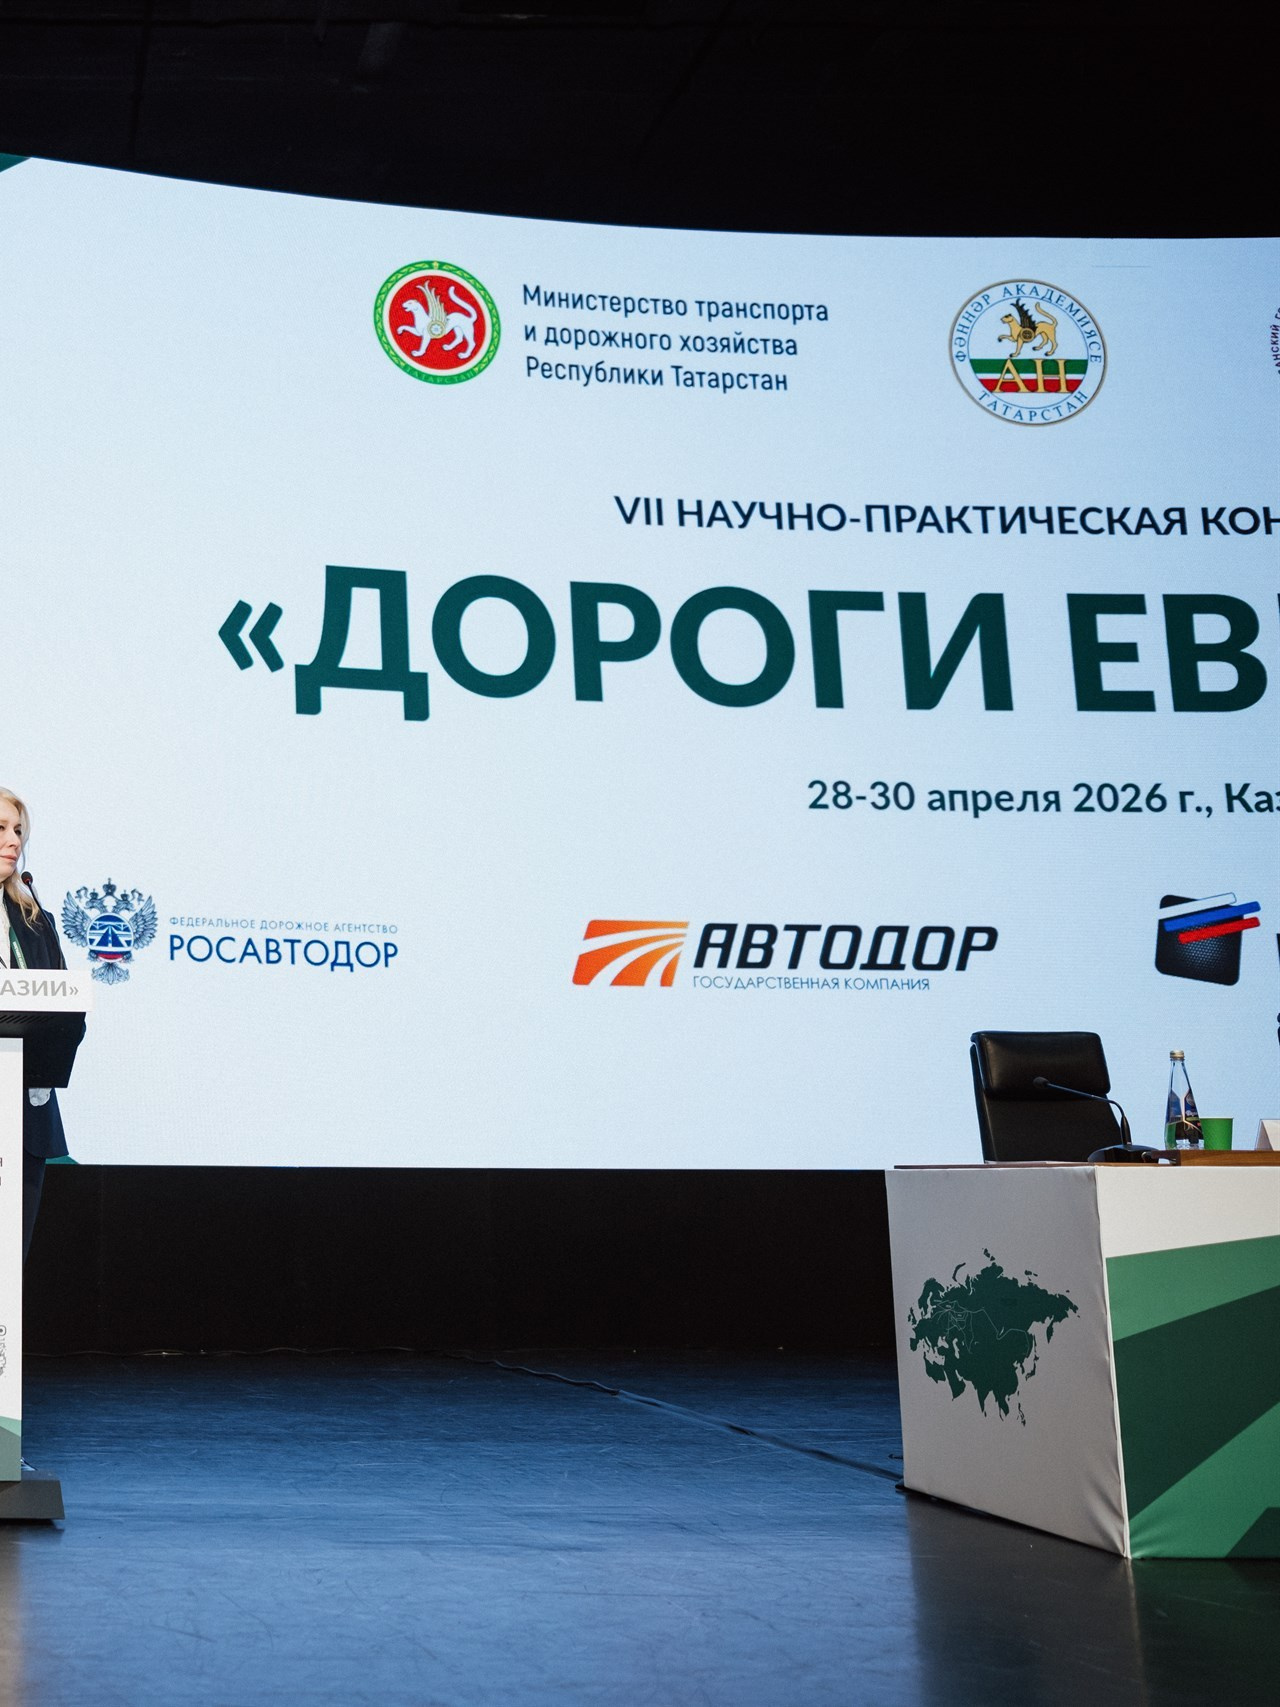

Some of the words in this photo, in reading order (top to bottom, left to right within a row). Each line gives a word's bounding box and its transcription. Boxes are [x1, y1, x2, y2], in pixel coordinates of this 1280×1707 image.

[523, 284, 687, 318] Министерство
[695, 300, 829, 325] транспорта
[1002, 284, 1102, 363] АКАДЕМИЯСЕ
[524, 324, 537, 341] и
[544, 326, 671, 350] дорожного
[680, 332, 797, 356] хозяйства
[526, 356, 663, 387] Республики
[671, 365, 788, 394] Татарстан
[991, 358, 1074, 394] АН
[977, 390, 1089, 422] ТАТАРСТАН
[614, 496, 665, 526] VII
[678, 499, 1188, 536] НАУЧНО-ПРАКТИЧЕСКАЯ
[218, 564, 1014, 722] «ДОРОГИ
[1066, 593, 1280, 712] ЕВ
[808, 780, 916, 811] 28-30
[927, 788, 1061, 818] апреля
[1072, 783, 1168, 813] 2026
[1179, 791, 1213, 818] г.,
[169, 917, 256, 929] ФЕДЕРАЛЬНОЕ
[260, 920, 330, 932] ДОРОЖНОЕ
[334, 923, 398, 935] АГЕНТСТВО
[169, 934, 399, 973] РОСАВТОДОР
[693, 923, 999, 971] АВТОДОР
[693, 975, 840, 991] ГОСУДАРСТВЕННАЯ
[844, 976, 931, 991] КОМПАНИЯ
